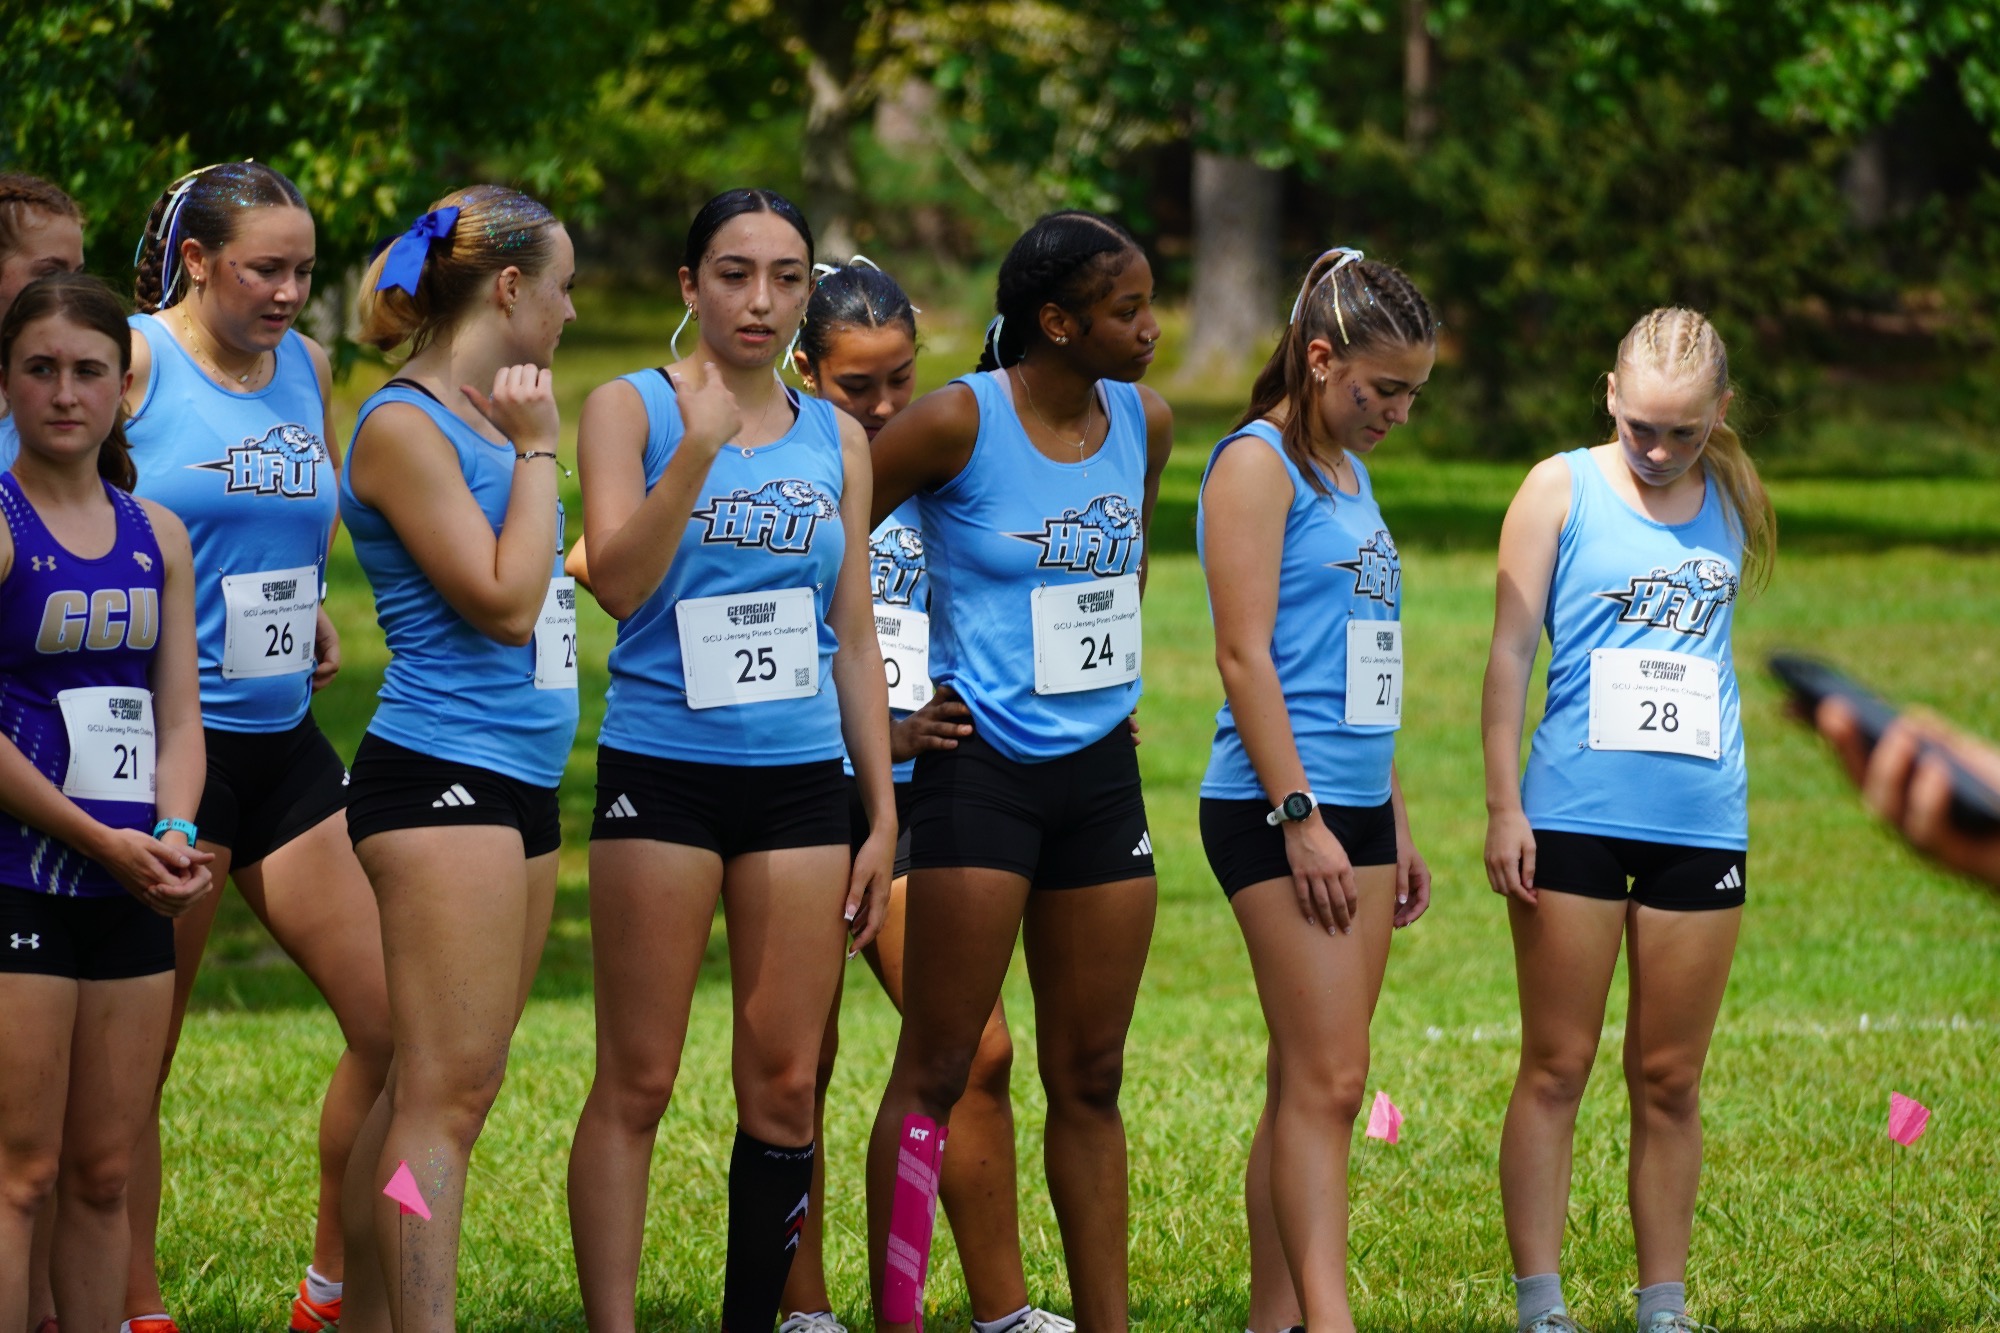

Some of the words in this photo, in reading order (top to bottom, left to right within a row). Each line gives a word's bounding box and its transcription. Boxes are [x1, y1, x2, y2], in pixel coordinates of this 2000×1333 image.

[226, 447, 317, 499] HFU
[701, 497, 818, 556] HFU
[1038, 519, 1132, 578] HFU
[262, 579, 297, 593] GEORGIAN
[869, 552, 920, 606] FU
[273, 589, 296, 602] COURT
[1077, 588, 1115, 605] GEORGIAN
[243, 609, 258, 618] GCU
[259, 607, 278, 616] Jersey
[279, 604, 293, 613] Pines
[727, 601, 777, 617] GEORGIAN
[1089, 599, 1113, 613] COURT
[1617, 577, 1718, 636] HFU
[35, 587, 159, 654] GCU
[742, 612, 776, 626] COURT
[874, 616, 902, 627] ORGIAN
[1053, 622, 1072, 631] GCU
[1073, 618, 1096, 628] Jersey
[1096, 616, 1111, 625] Pines
[265, 621, 294, 657] 26
[702, 635, 723, 643] GCU
[724, 632, 751, 641] Jersey
[752, 628, 772, 638] Pines
[773, 625, 809, 635] Challenge
[1080, 632, 1114, 671] 24
[734, 646, 778, 684] 25
[1639, 660, 1687, 673] GEORGIAN
[1653, 669, 1685, 682] COURT
[1376, 673, 1392, 706] 27
[1611, 682, 1631, 690] GCU
[1633, 683, 1658, 692] Jersey
[1660, 685, 1680, 694] Pines
[108, 698, 143, 710] GEORGIAN
[1638, 700, 1679, 733] 28
[87, 724, 104, 732] GCU
[105, 725, 126, 735] Jersey
[113, 743, 137, 780] 21
[909, 1126, 930, 1142] KT
